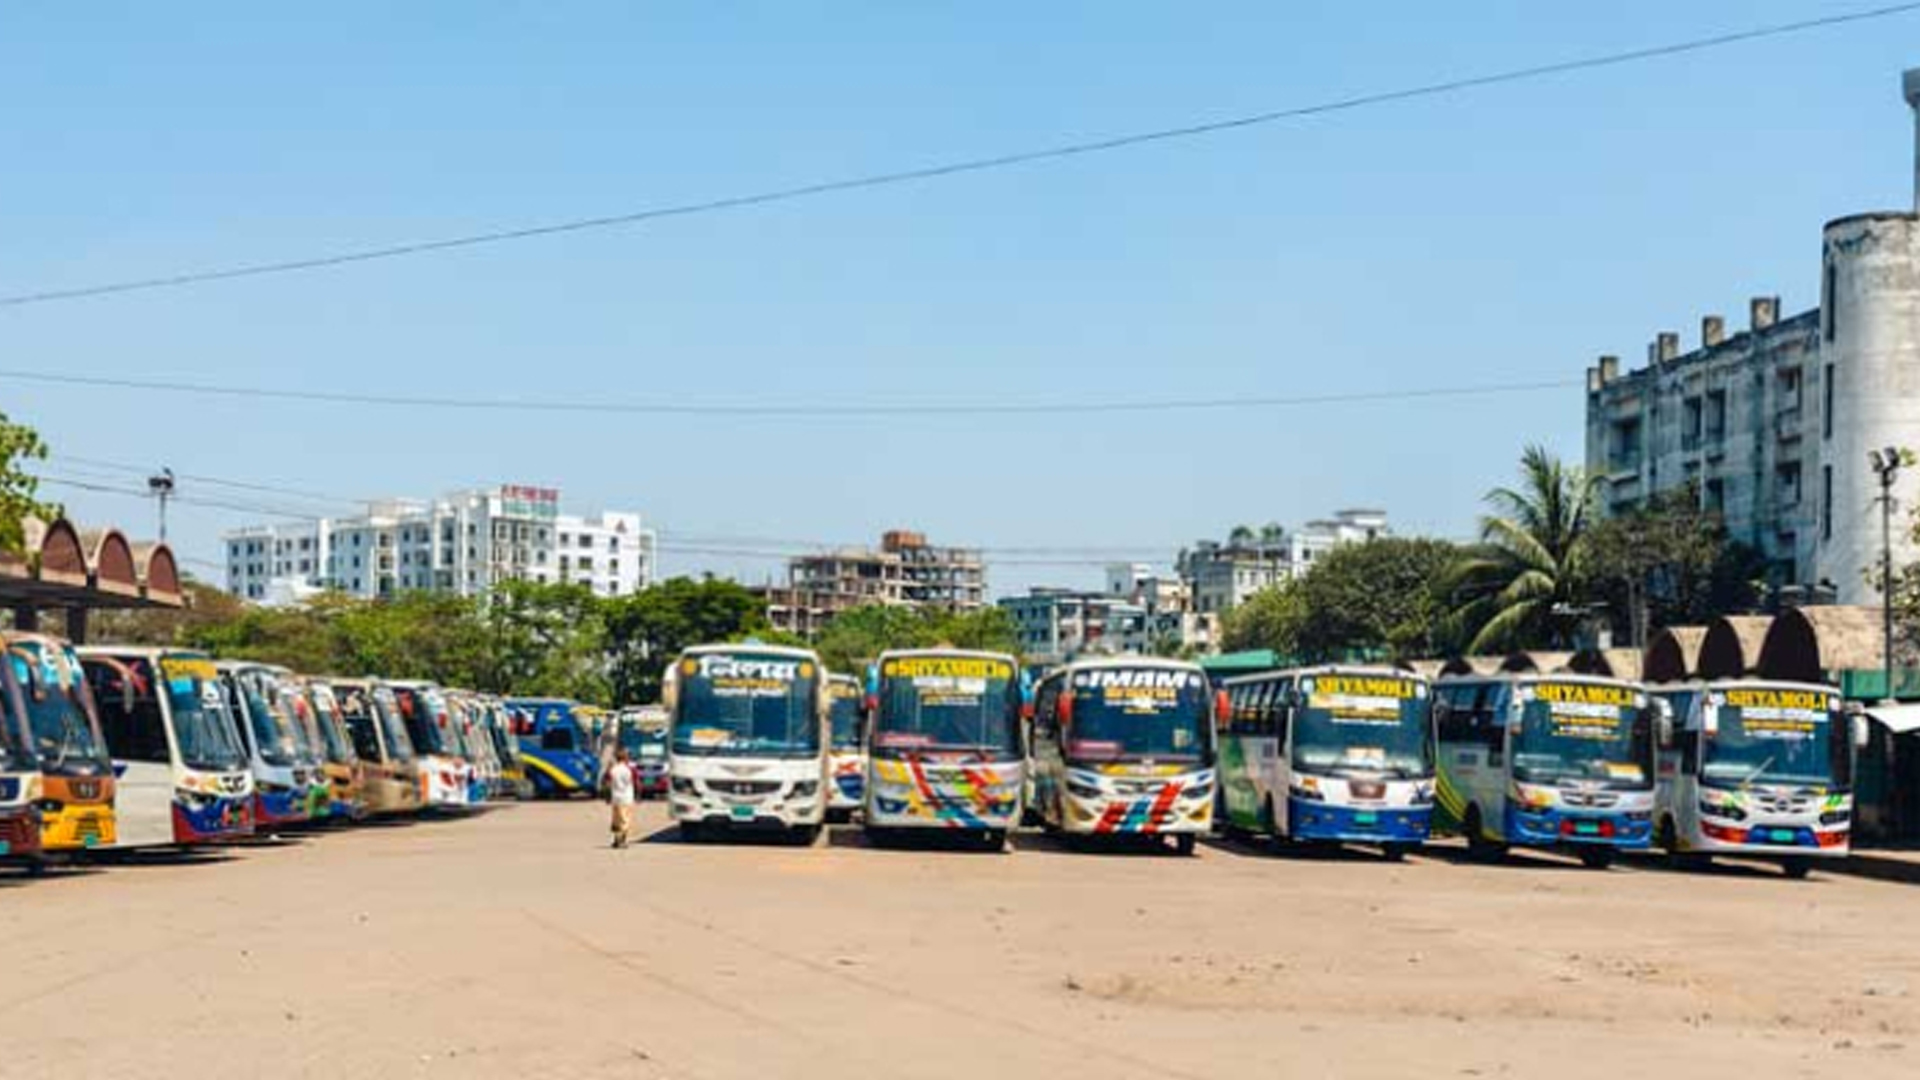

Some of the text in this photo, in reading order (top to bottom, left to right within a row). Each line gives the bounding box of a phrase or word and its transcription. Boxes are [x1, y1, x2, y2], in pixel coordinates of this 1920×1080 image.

[1089, 670, 1187, 689] IMAM
[1316, 676, 1413, 699] SHYAMOLI
[1535, 683, 1633, 708] SHYAMOLI
[1727, 689, 1828, 711] SHYAMOLI
